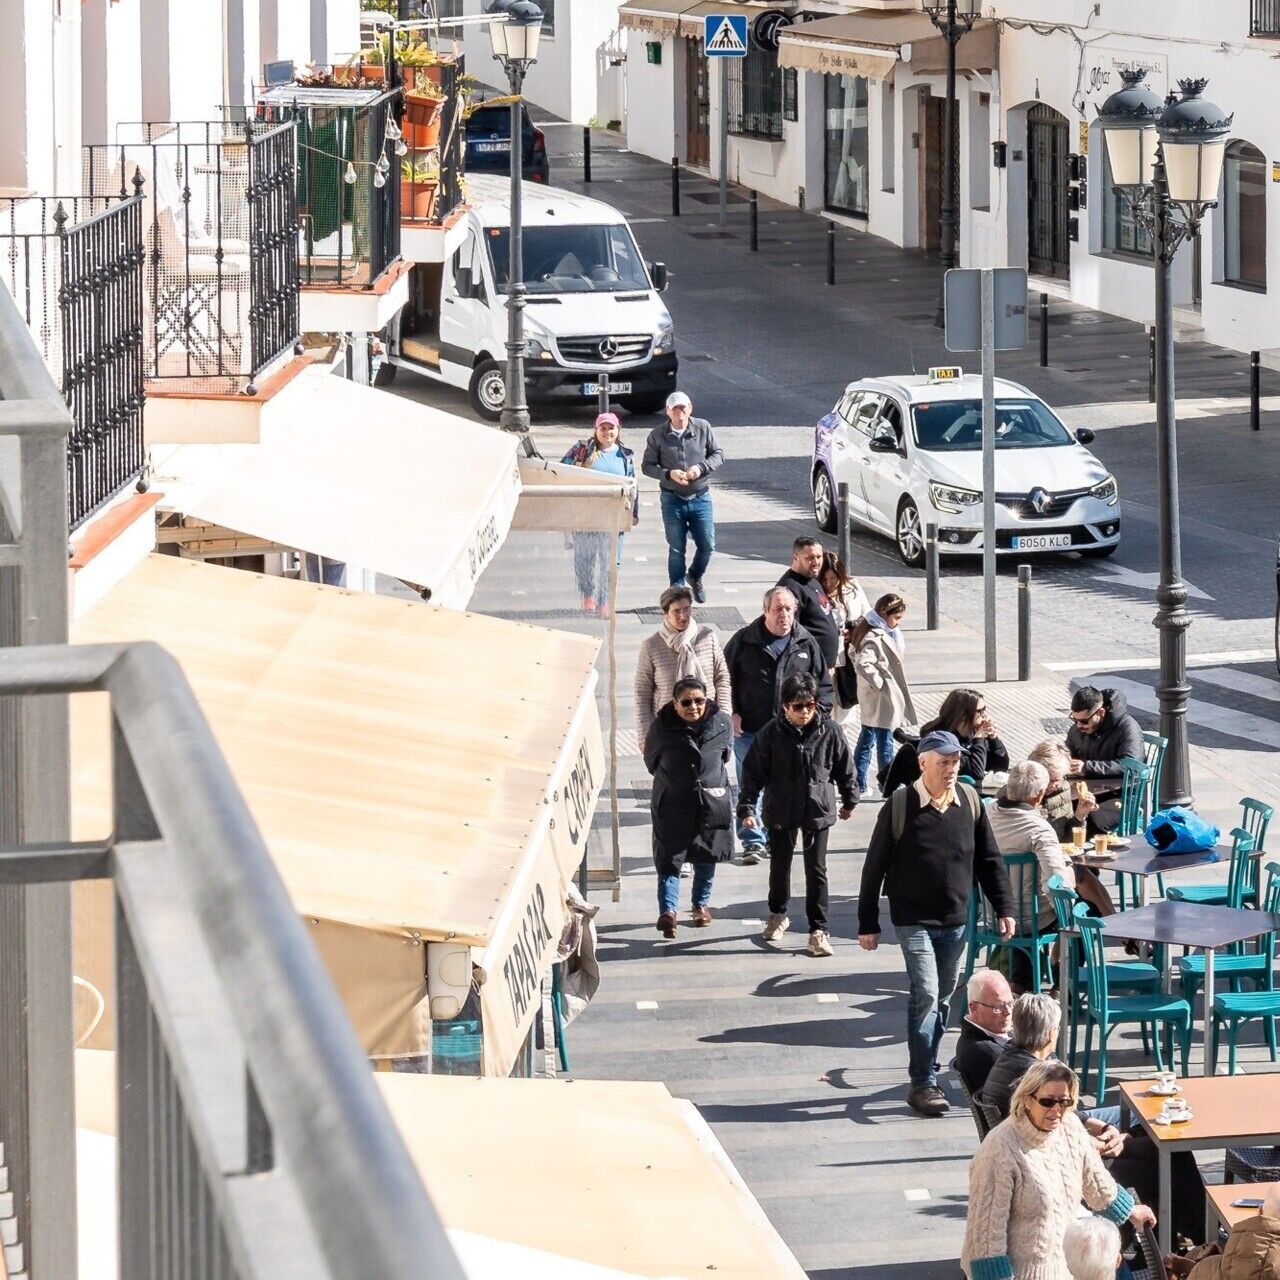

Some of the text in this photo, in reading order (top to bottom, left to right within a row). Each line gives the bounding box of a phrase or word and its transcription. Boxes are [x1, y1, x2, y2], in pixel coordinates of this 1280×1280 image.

[938, 369, 954, 378] TAXI
[1019, 536, 1069, 549] 6050 KLC
